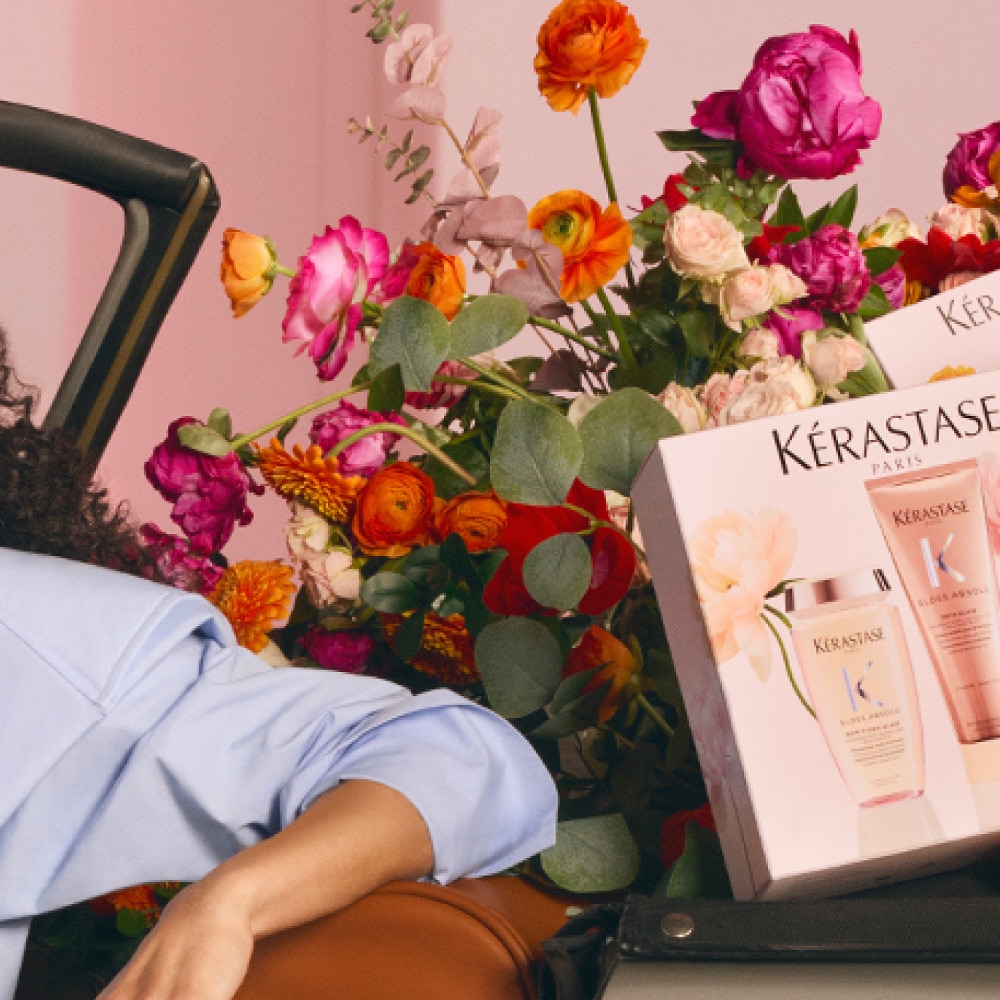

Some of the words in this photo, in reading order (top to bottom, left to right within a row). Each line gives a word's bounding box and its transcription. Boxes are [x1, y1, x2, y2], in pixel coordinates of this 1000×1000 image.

[771, 395, 1000, 476] KÉRASTASE
[870, 453, 923, 475] PARIS
[919, 531, 967, 588] K
[841, 660, 884, 712] K
